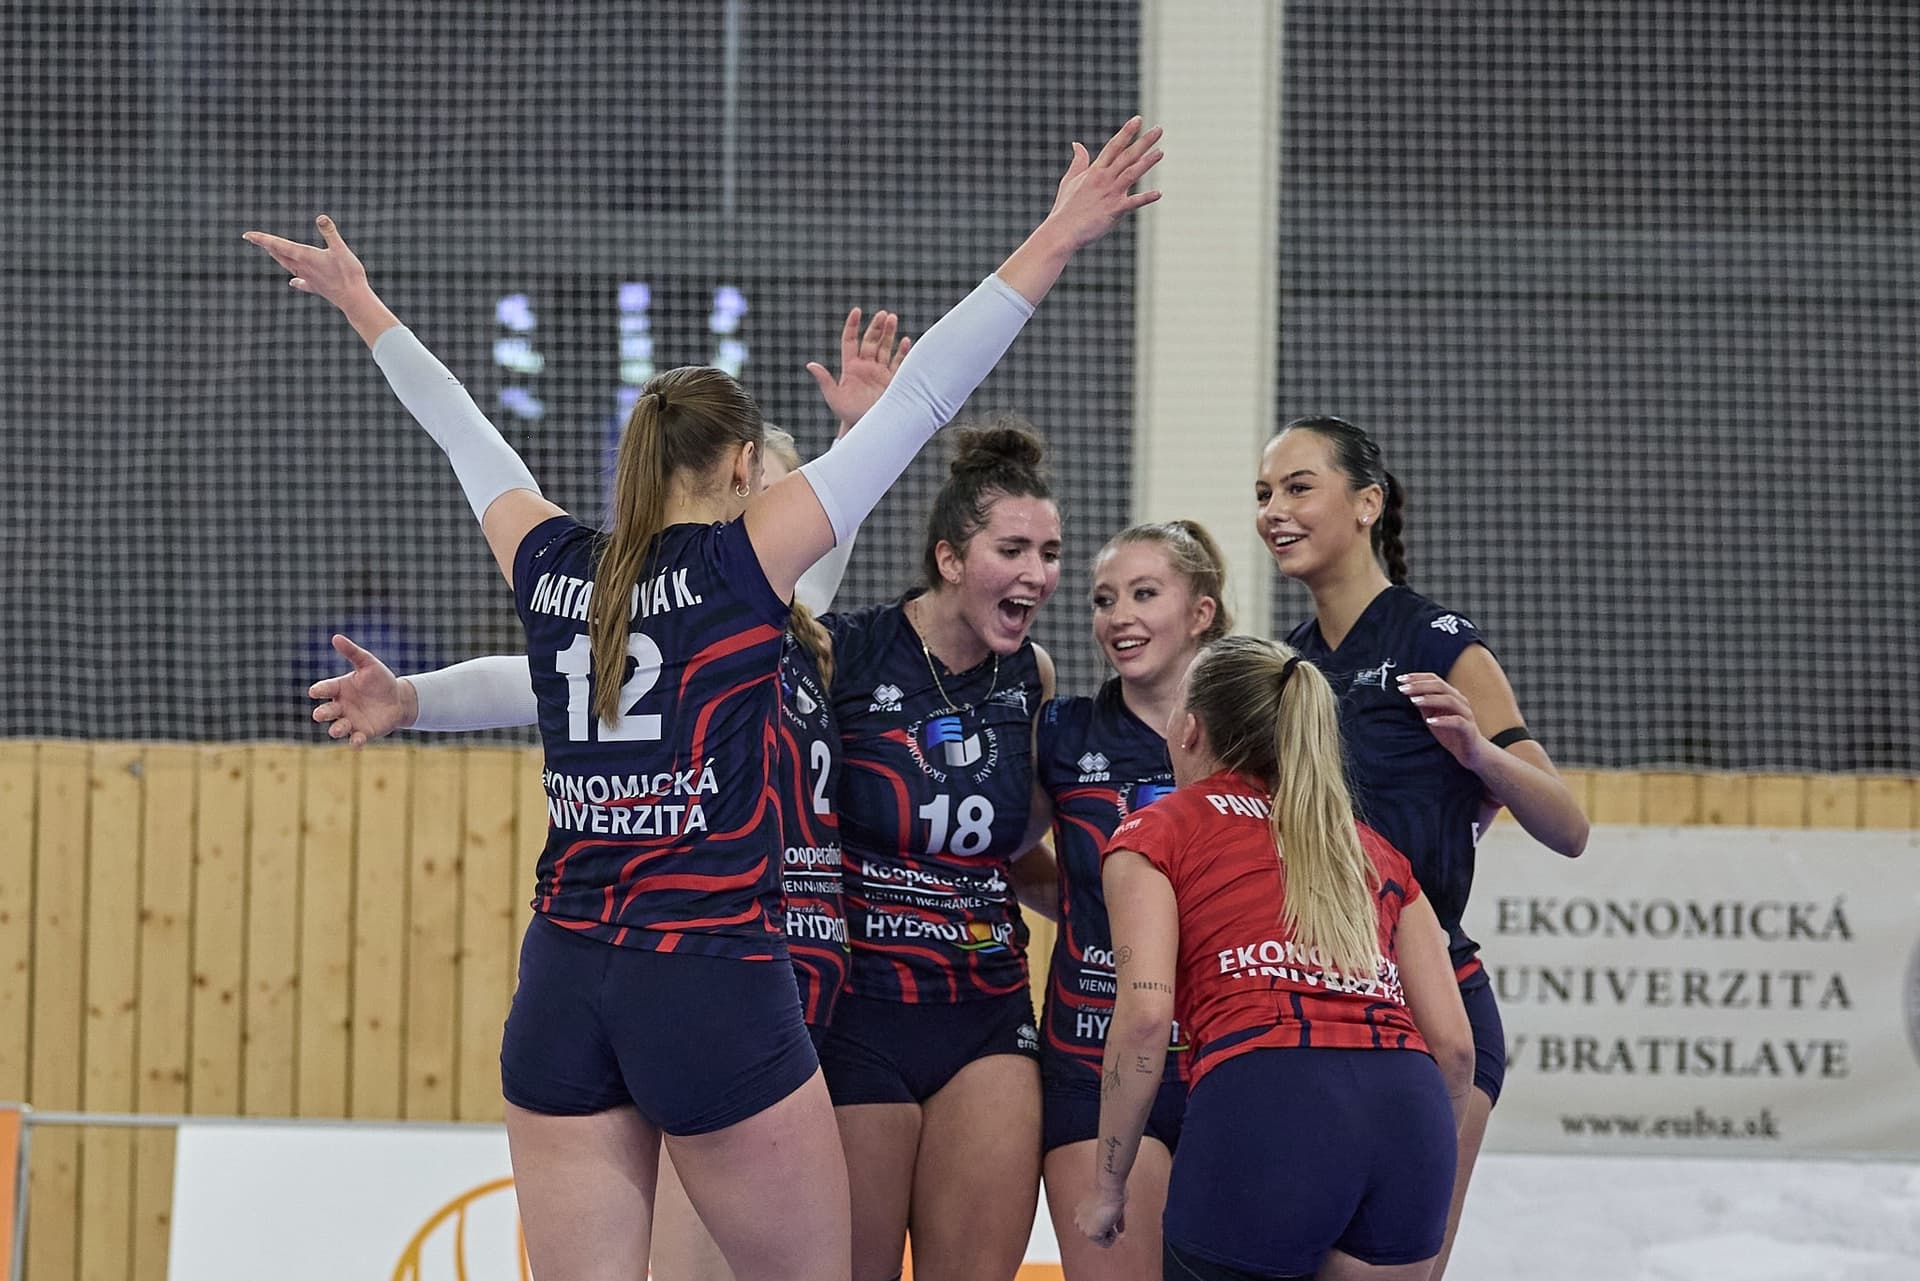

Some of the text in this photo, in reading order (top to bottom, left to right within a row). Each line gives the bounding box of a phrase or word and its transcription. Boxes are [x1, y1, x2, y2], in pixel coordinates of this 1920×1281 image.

[556, 632, 664, 742] 12
[811, 740, 832, 815] 2
[548, 797, 709, 836] NIVERZITA
[919, 794, 995, 857] 18
[1495, 895, 1853, 942] EKONOMICKÁ
[1079, 979, 1116, 994] VIENN
[1494, 967, 1852, 1010] UNIVERZITA
[1537, 1034, 1850, 1078] BRATISLAVE
[1560, 1108, 1781, 1139] www.euba.sk
